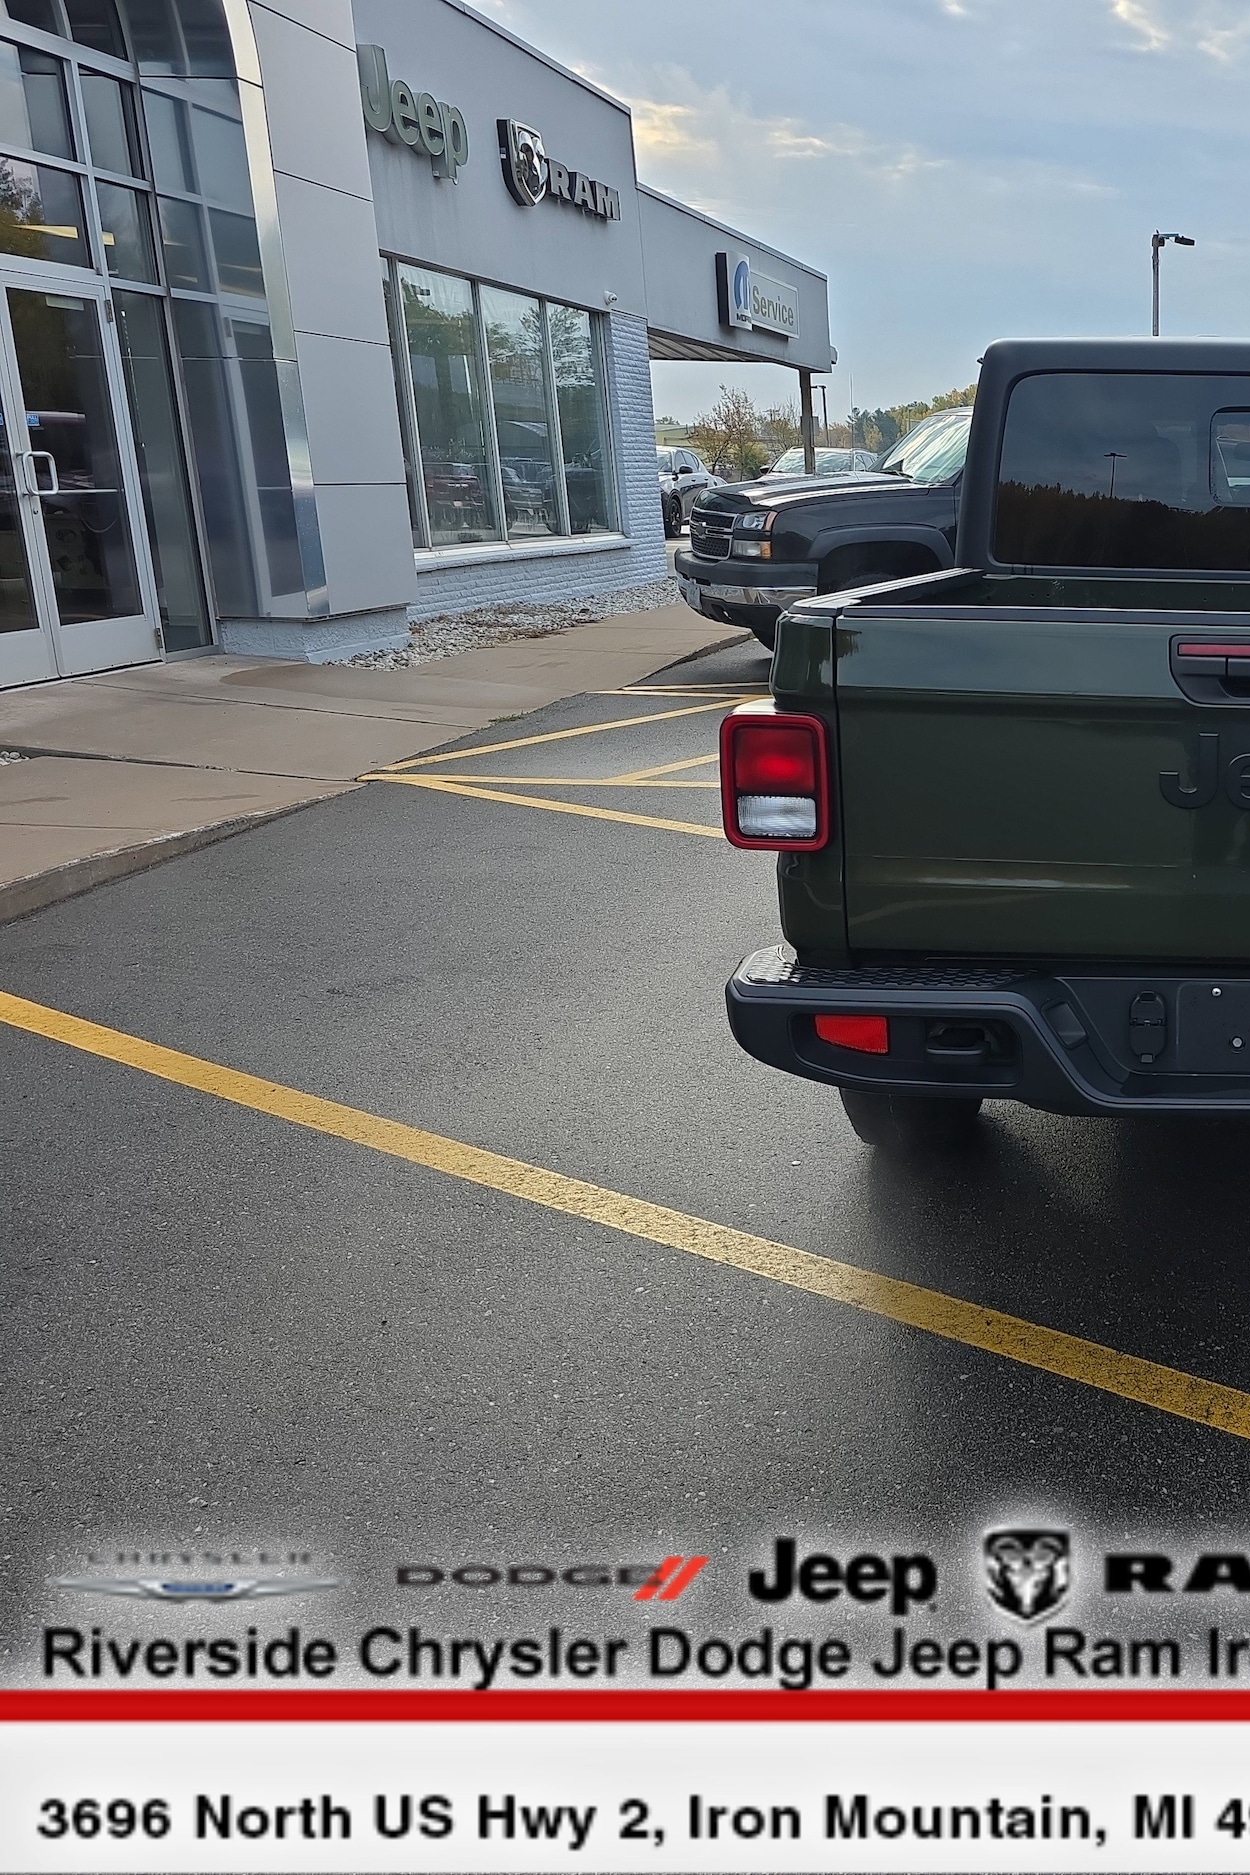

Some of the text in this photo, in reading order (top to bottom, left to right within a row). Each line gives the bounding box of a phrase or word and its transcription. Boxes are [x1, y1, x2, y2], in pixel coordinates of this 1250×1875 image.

[356, 44, 469, 185] Jeep
[544, 157, 621, 221] RAM
[753, 285, 794, 326] Service
